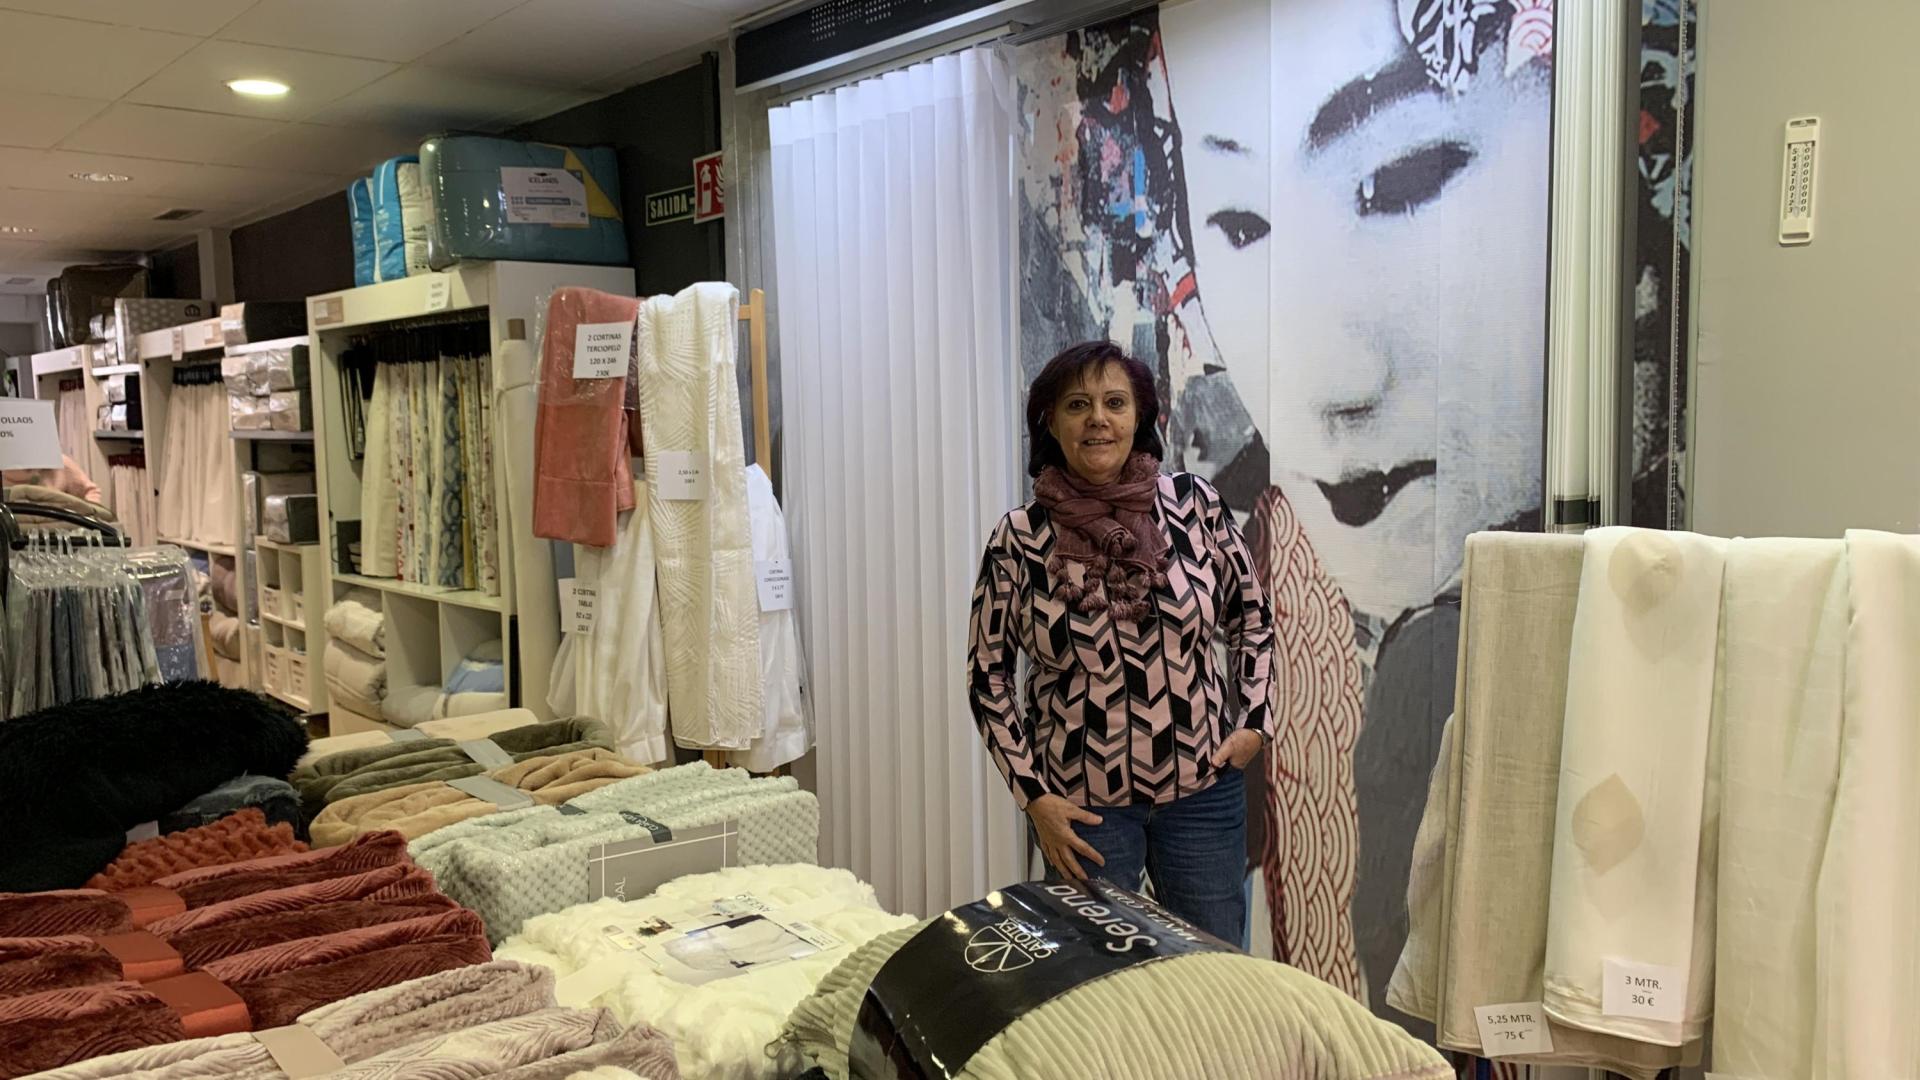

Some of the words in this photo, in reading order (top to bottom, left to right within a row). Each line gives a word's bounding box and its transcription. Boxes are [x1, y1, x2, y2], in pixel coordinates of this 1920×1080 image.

[650, 193, 688, 219] SALIDA
[587, 334, 592, 342] 2
[593, 333, 622, 341] CORTINAS
[586, 344, 621, 353] TERCIOPELO
[1044, 885, 1158, 954] Serena
[994, 918, 1054, 960] CATOTEX
[1625, 976, 1632, 985] 3
[1634, 977, 1662, 990] MTR.
[1631, 994, 1645, 1005] 30
[1647, 997, 1654, 1007] €
[1487, 1015, 1508, 1025] 5,25
[1510, 1014, 1535, 1024] MTR.
[1504, 1031, 1516, 1040] 75
[1518, 1031, 1525, 1040] €
